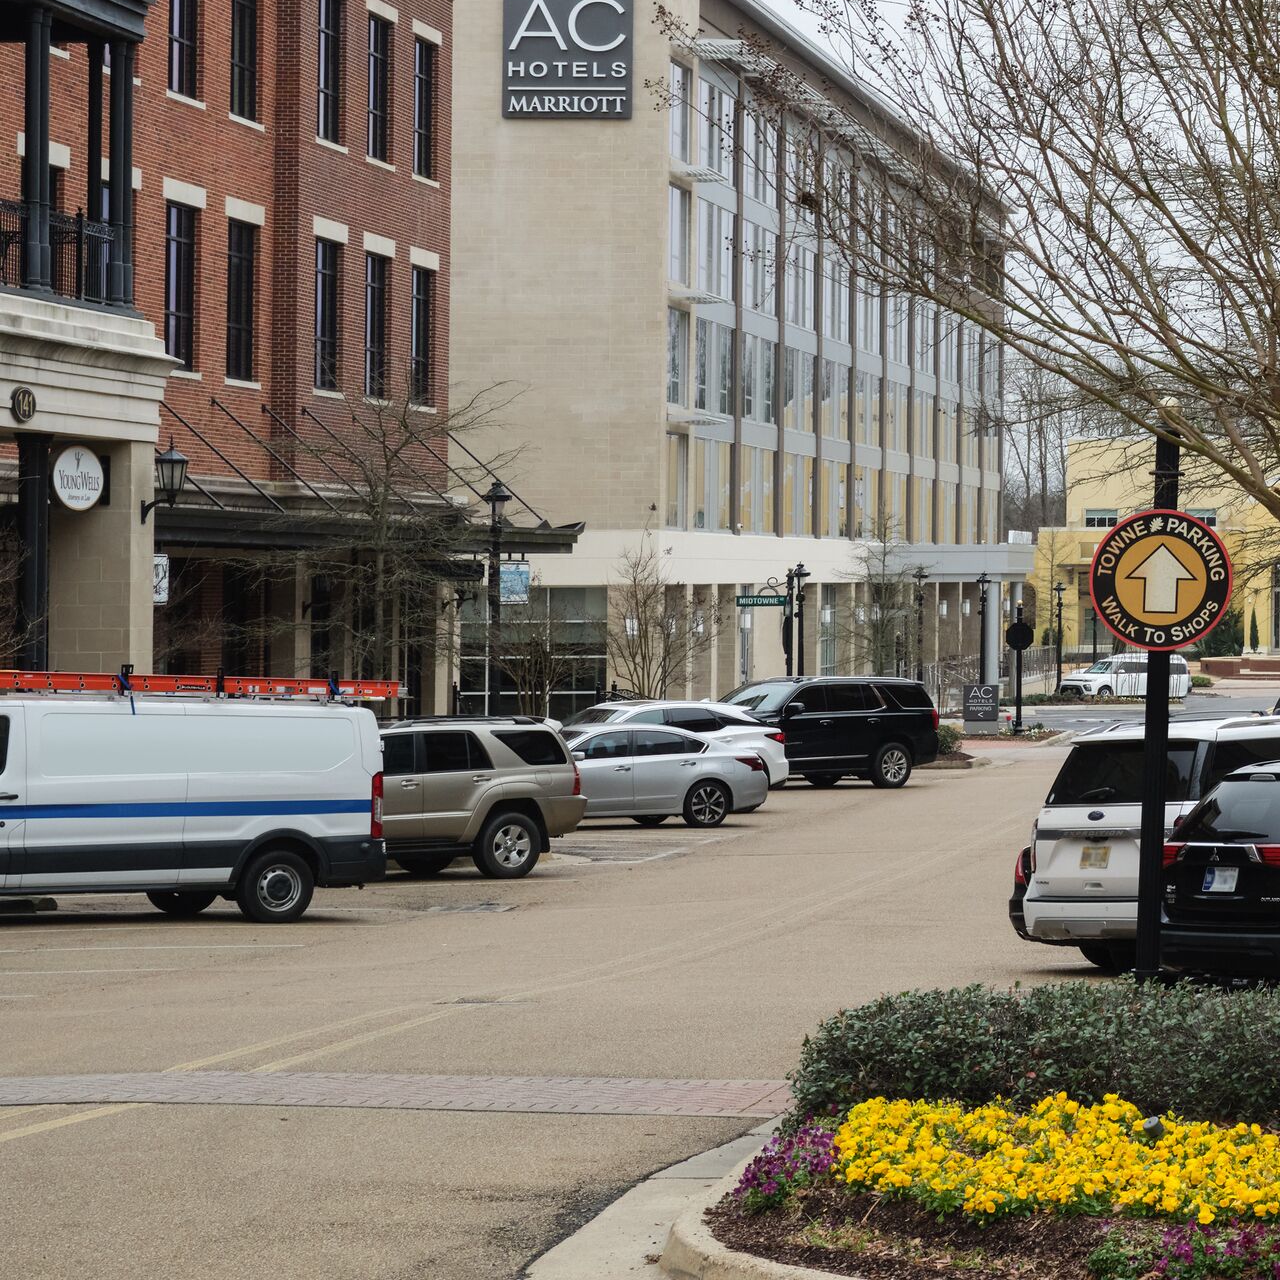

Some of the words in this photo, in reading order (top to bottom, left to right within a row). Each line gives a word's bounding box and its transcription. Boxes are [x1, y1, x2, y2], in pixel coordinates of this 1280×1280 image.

[507, 61, 627, 77] HOTELS
[507, 95, 626, 113] MARRIOTT
[19, 393, 33, 416] 141
[1097, 520, 1148, 577] TOWNE
[1166, 517, 1225, 582] PARKING
[1101, 596, 1139, 638] WALK
[1143, 627, 1165, 644] TO
[1170, 600, 1218, 641] SHOPS
[969, 686, 993, 698] AC
